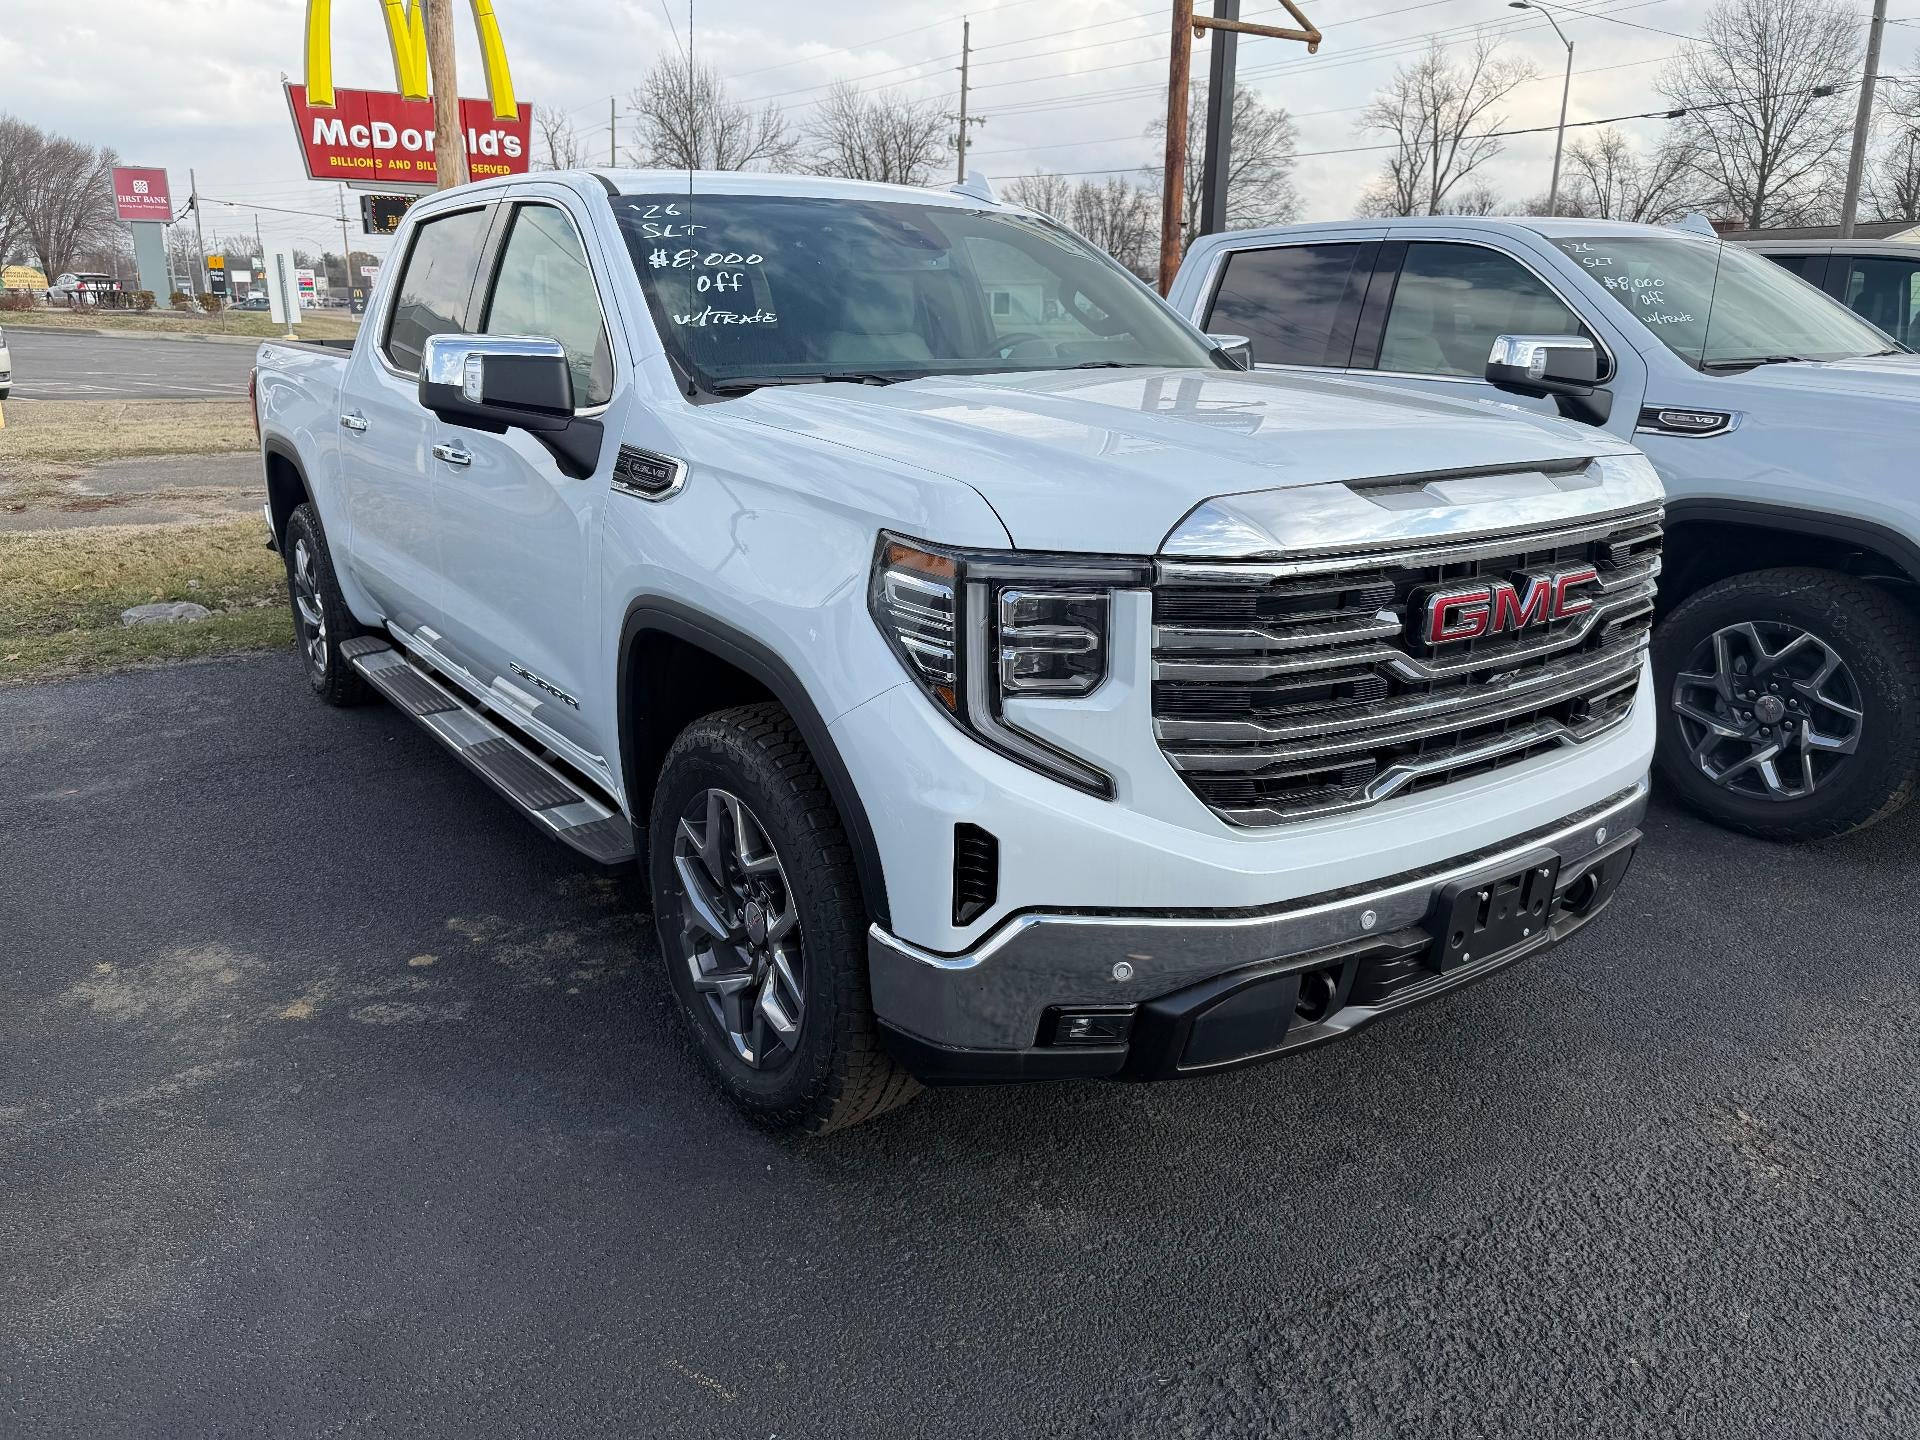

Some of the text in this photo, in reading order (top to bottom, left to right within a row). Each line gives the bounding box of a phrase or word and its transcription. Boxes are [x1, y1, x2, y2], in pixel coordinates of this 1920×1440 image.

[312, 118, 522, 158] McDold's
[330, 156, 511, 175] BILLIONS AND BILL SERVED
[117, 195, 167, 204] FIRST BANK
[641, 222, 707, 239] SLT
[1582, 257, 1613, 268] SLT
[1423, 567, 1597, 647] GMC
